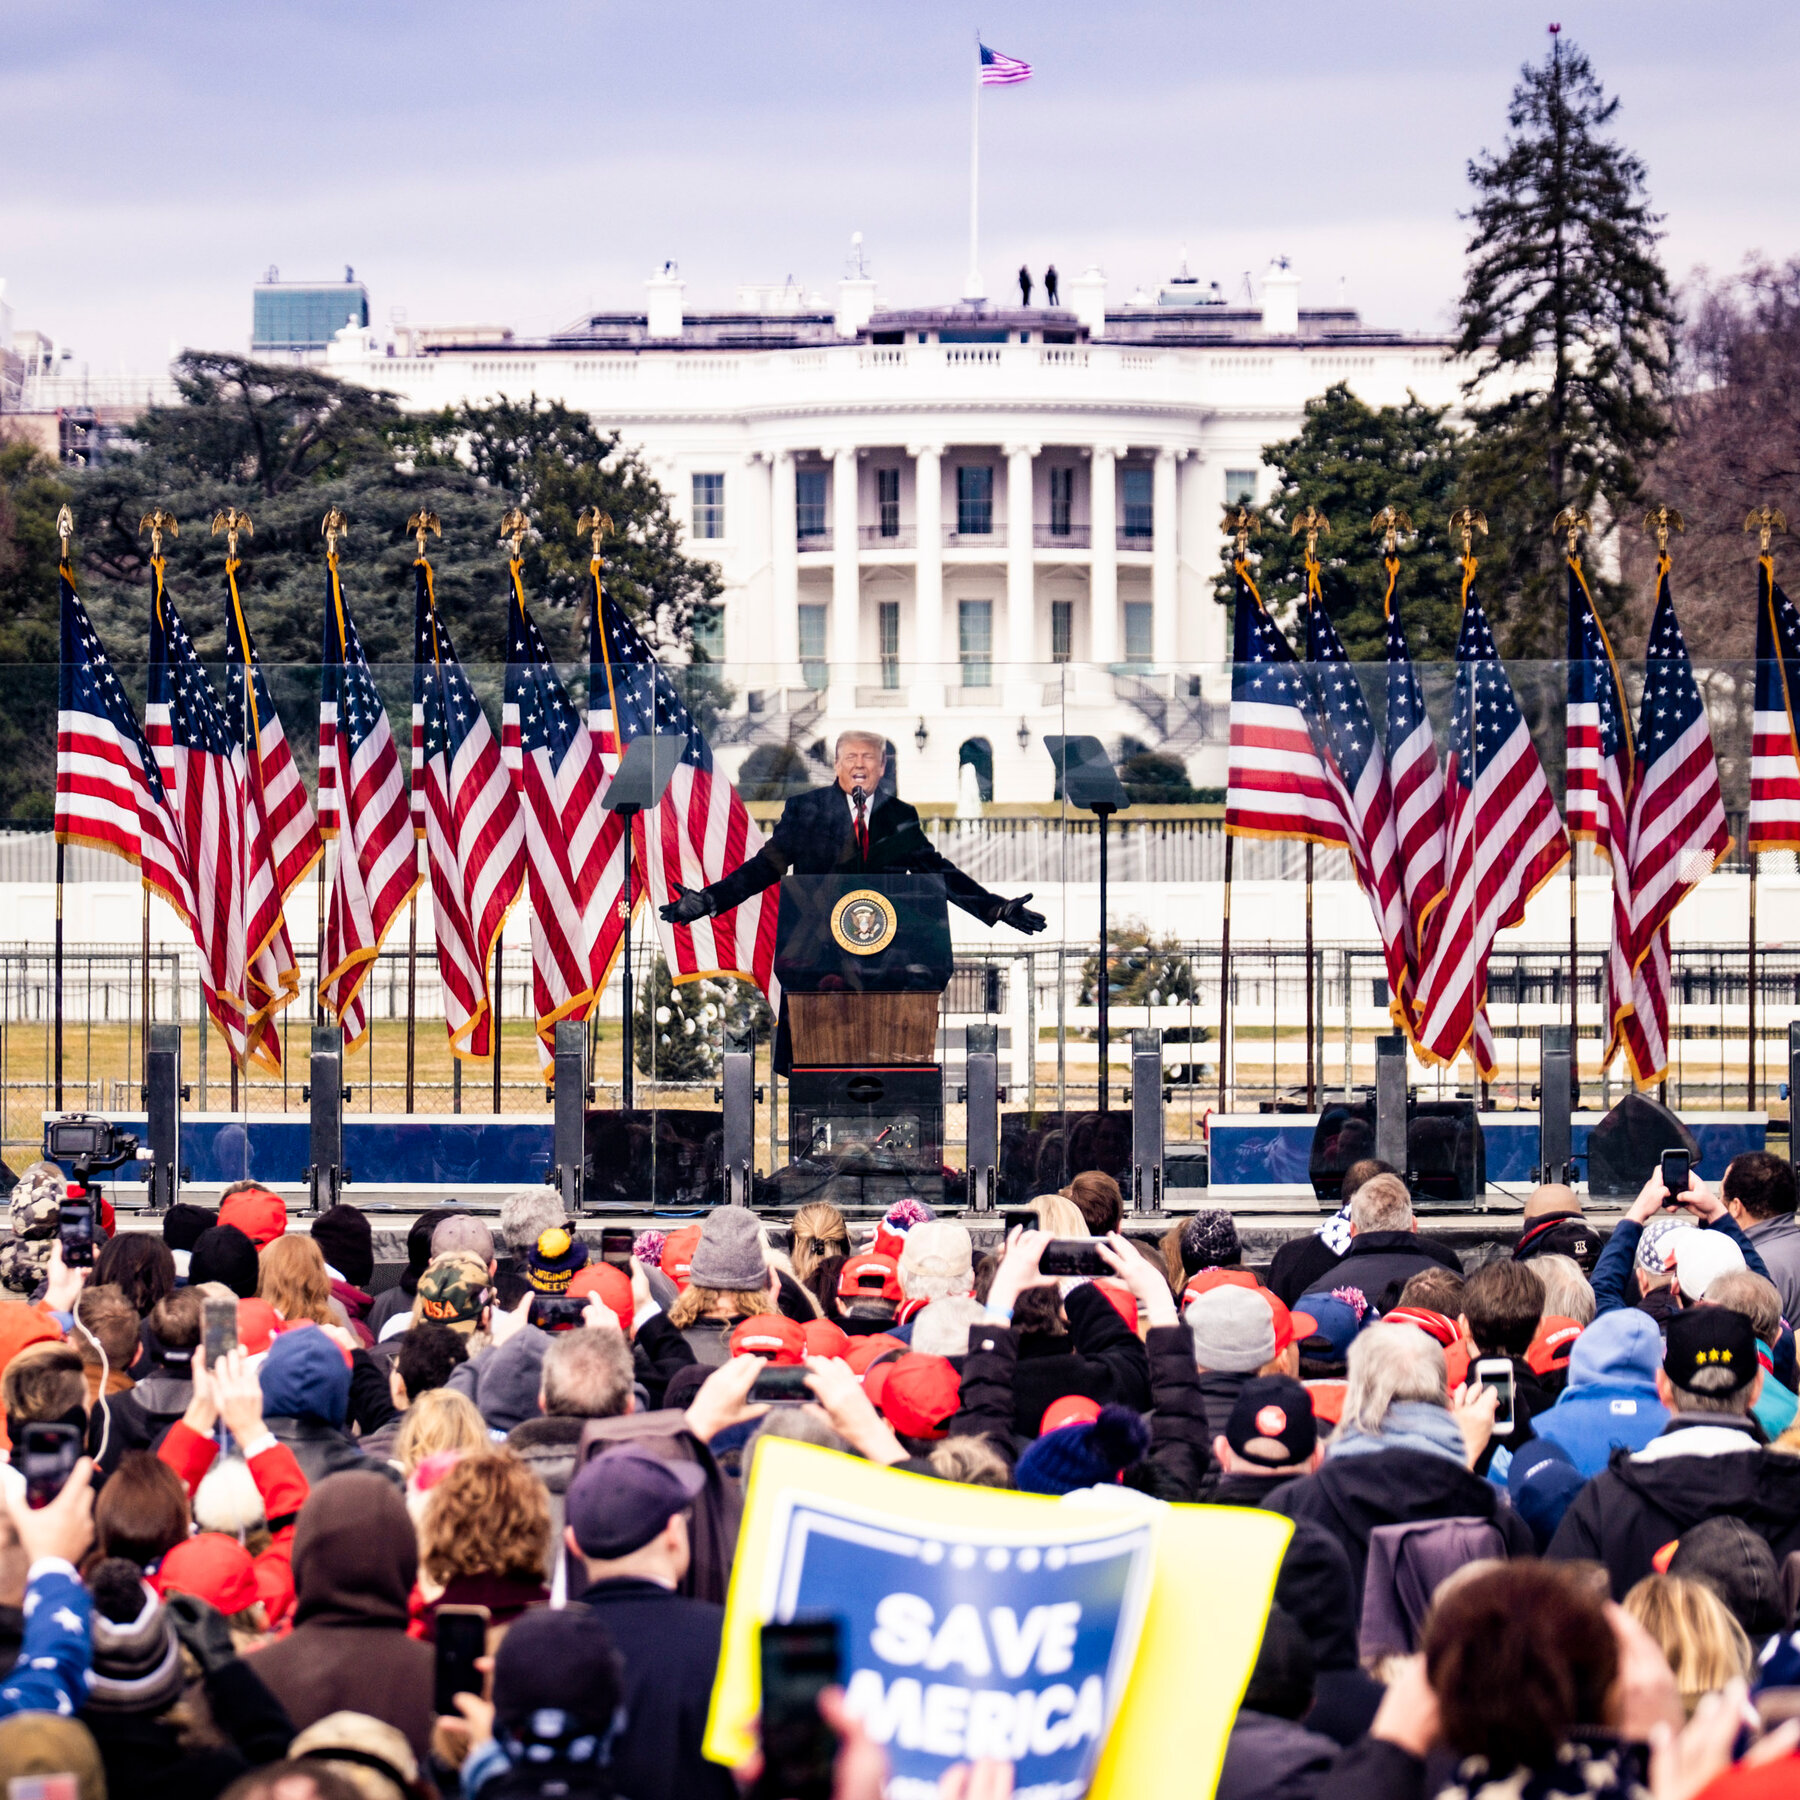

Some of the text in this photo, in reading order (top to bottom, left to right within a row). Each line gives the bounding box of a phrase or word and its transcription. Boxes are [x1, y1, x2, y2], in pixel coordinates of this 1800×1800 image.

[526, 1272, 573, 1292] TAINEERS
[534, 1268, 572, 1282] VIRGINIA
[424, 1298, 459, 1319] USA
[870, 1592, 1083, 1679] SAVE
[845, 1668, 1104, 1762] MERICA
